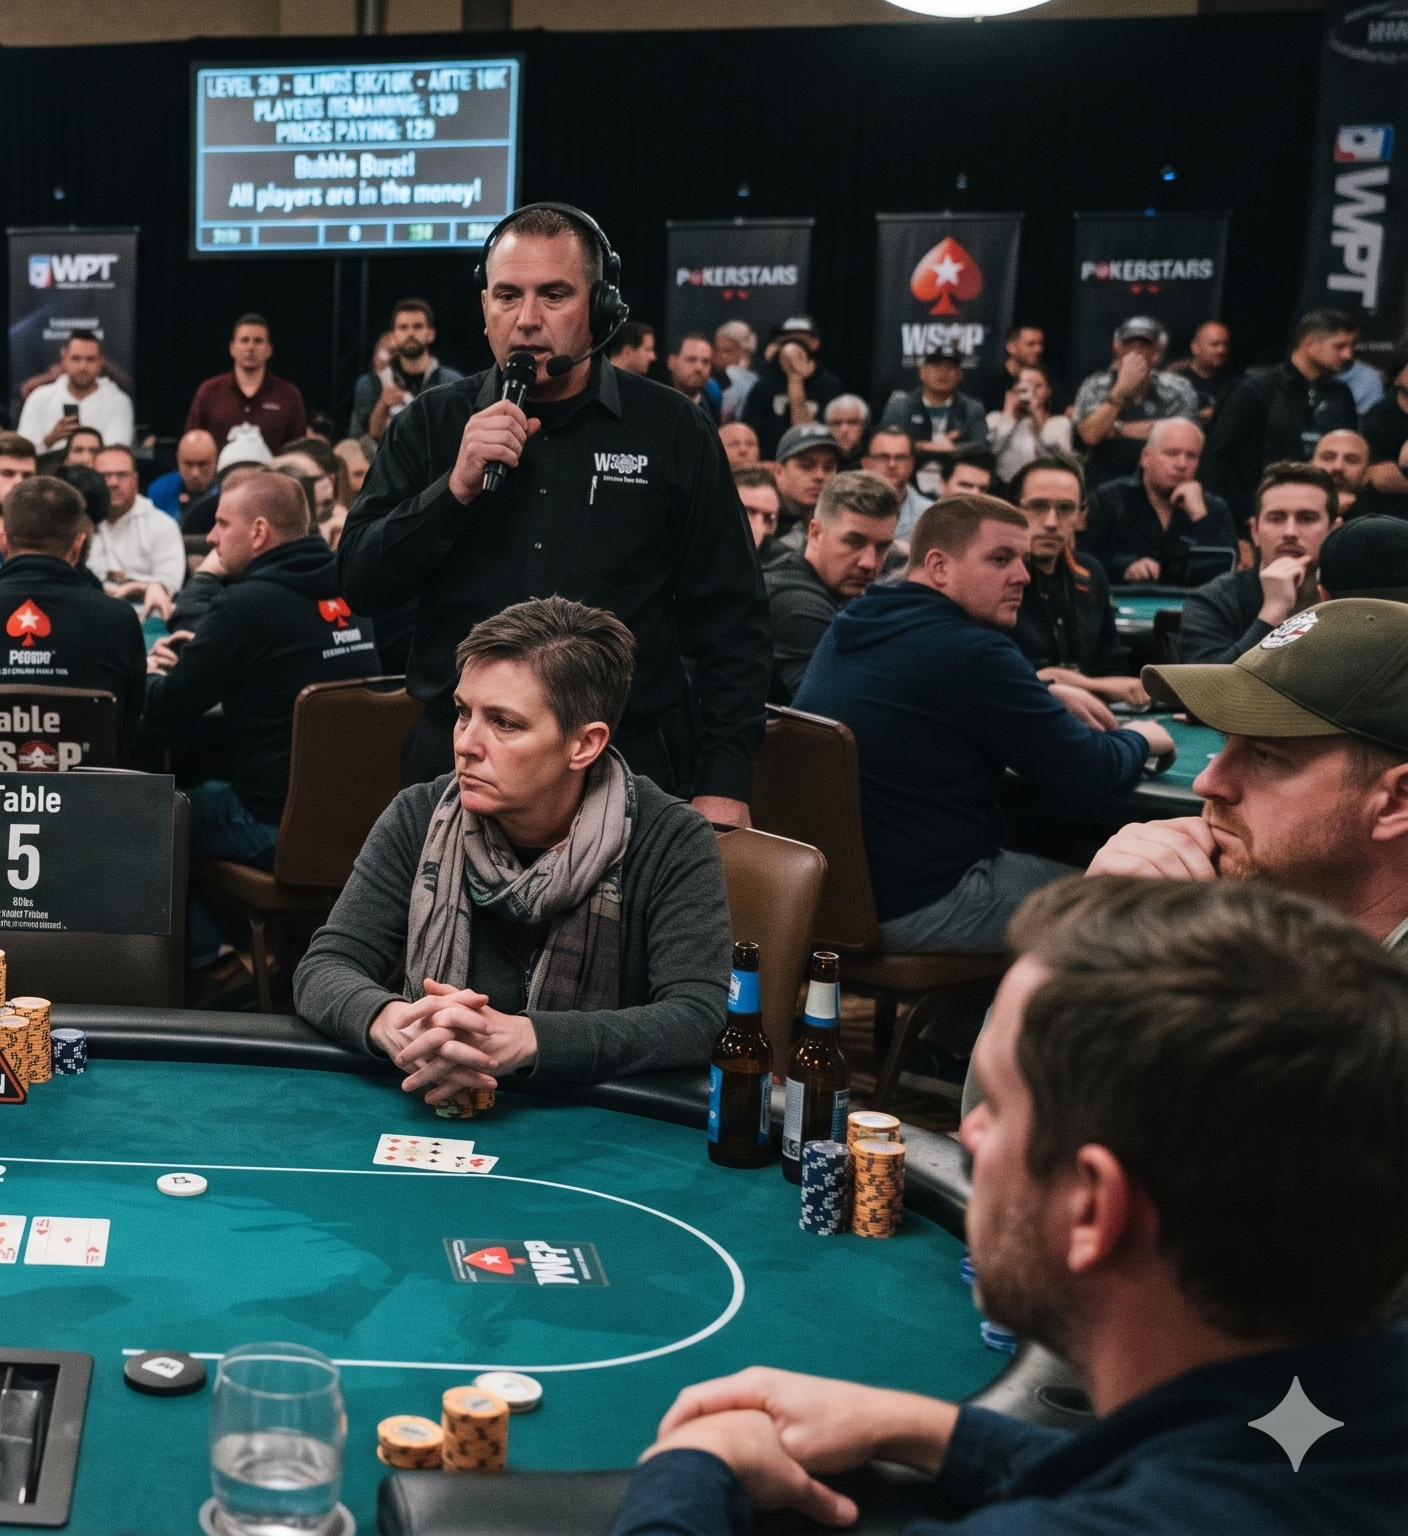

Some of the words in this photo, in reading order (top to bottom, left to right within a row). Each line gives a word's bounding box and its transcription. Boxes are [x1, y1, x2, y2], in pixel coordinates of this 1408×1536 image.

[206, 76, 256, 98] LEVEL
[253, 96, 325, 122] PLAYERS
[275, 119, 334, 144] PRIZES
[294, 152, 357, 179] Bubble
[359, 150, 416, 178] Burst!
[228, 181, 255, 208] All
[256, 181, 323, 213] players
[325, 186, 357, 207] are
[359, 179, 378, 205] in
[380, 178, 411, 206] the
[413, 177, 482, 209] money!
[1327, 166, 1390, 310] WPT
[51, 254, 119, 282] WPT
[676, 265, 798, 287] POKERSTARS
[1081, 258, 1213, 281] POKERSTARS
[7, 823, 41, 890] 5
